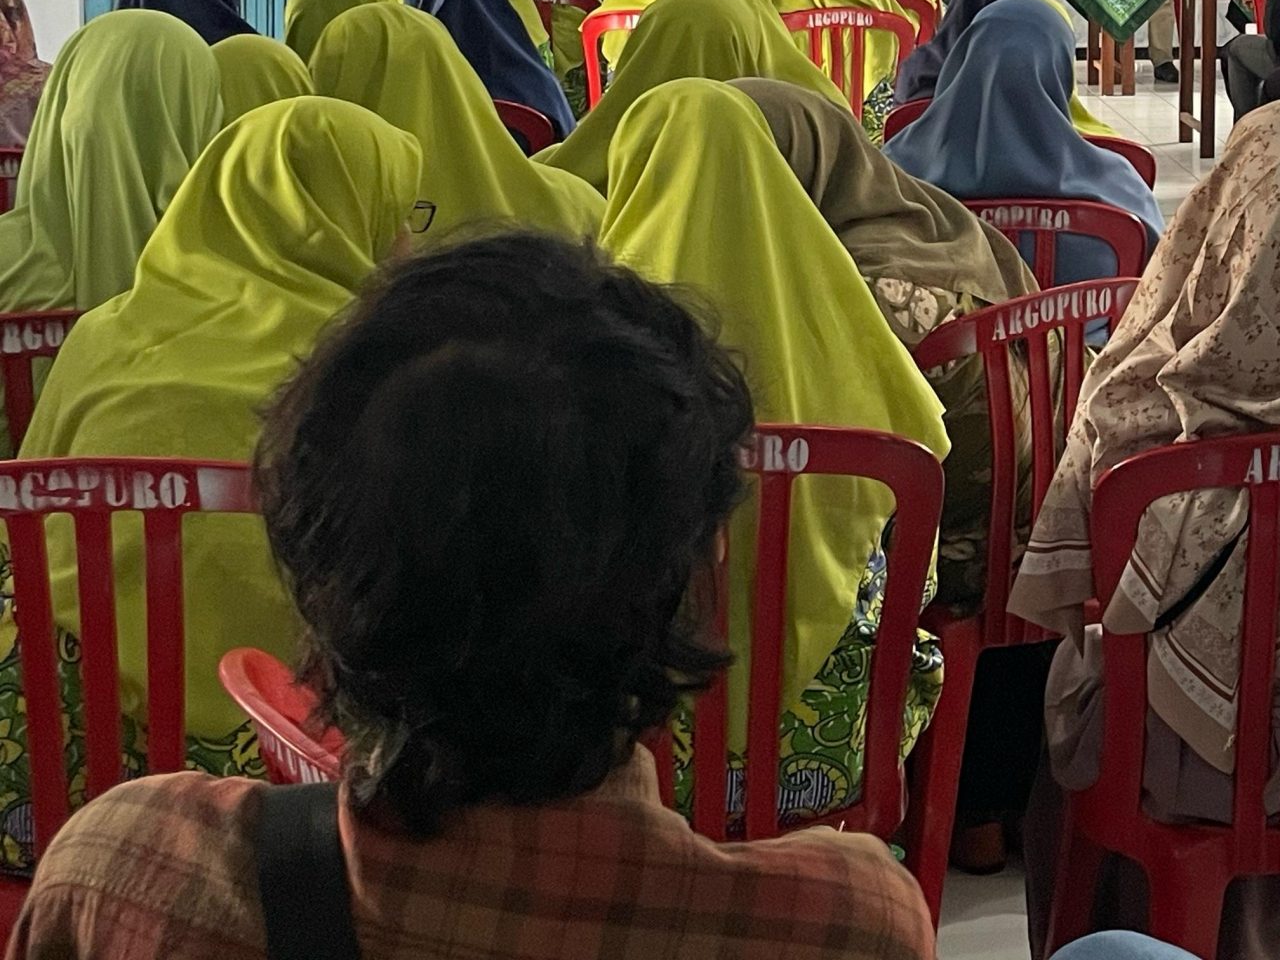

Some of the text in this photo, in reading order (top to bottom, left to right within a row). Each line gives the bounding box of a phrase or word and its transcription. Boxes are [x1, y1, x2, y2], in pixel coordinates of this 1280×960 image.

[806, 11, 874, 28] ARGOPURO
[980, 206, 1070, 229] GOPURO
[991, 287, 1112, 341] ARGOPURO
[0, 468, 191, 511] RGOPURO
